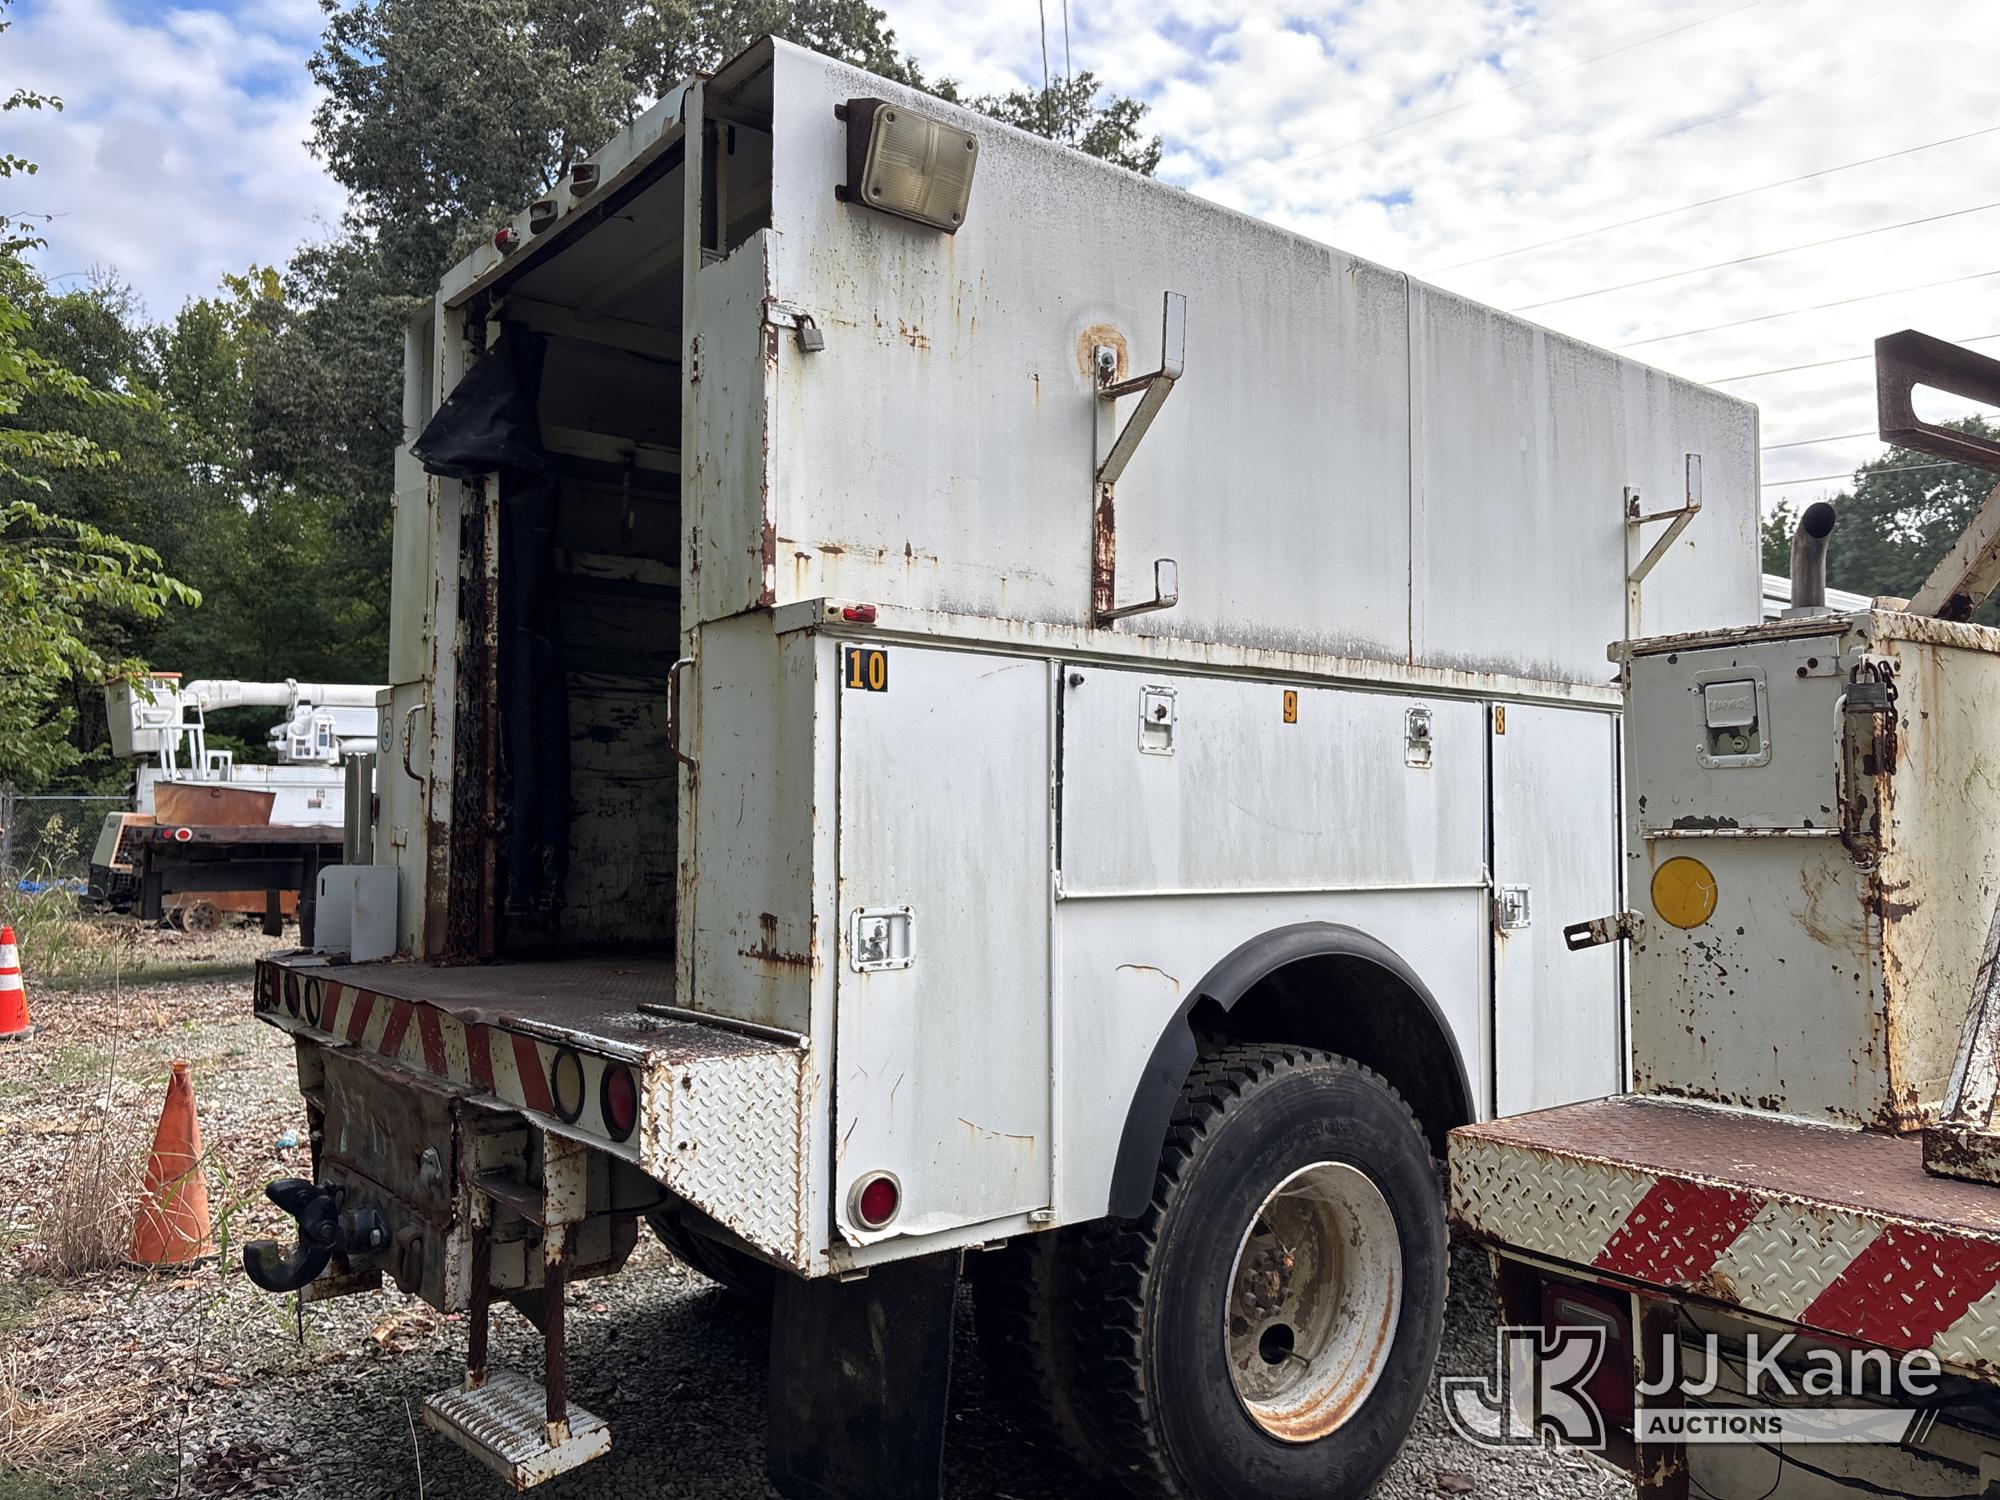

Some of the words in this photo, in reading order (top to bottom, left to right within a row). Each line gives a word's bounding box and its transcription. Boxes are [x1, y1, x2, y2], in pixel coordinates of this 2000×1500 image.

[849, 649, 885, 690] 10
[1284, 691, 1297, 722] 9
[1496, 706, 1505, 733] 8
